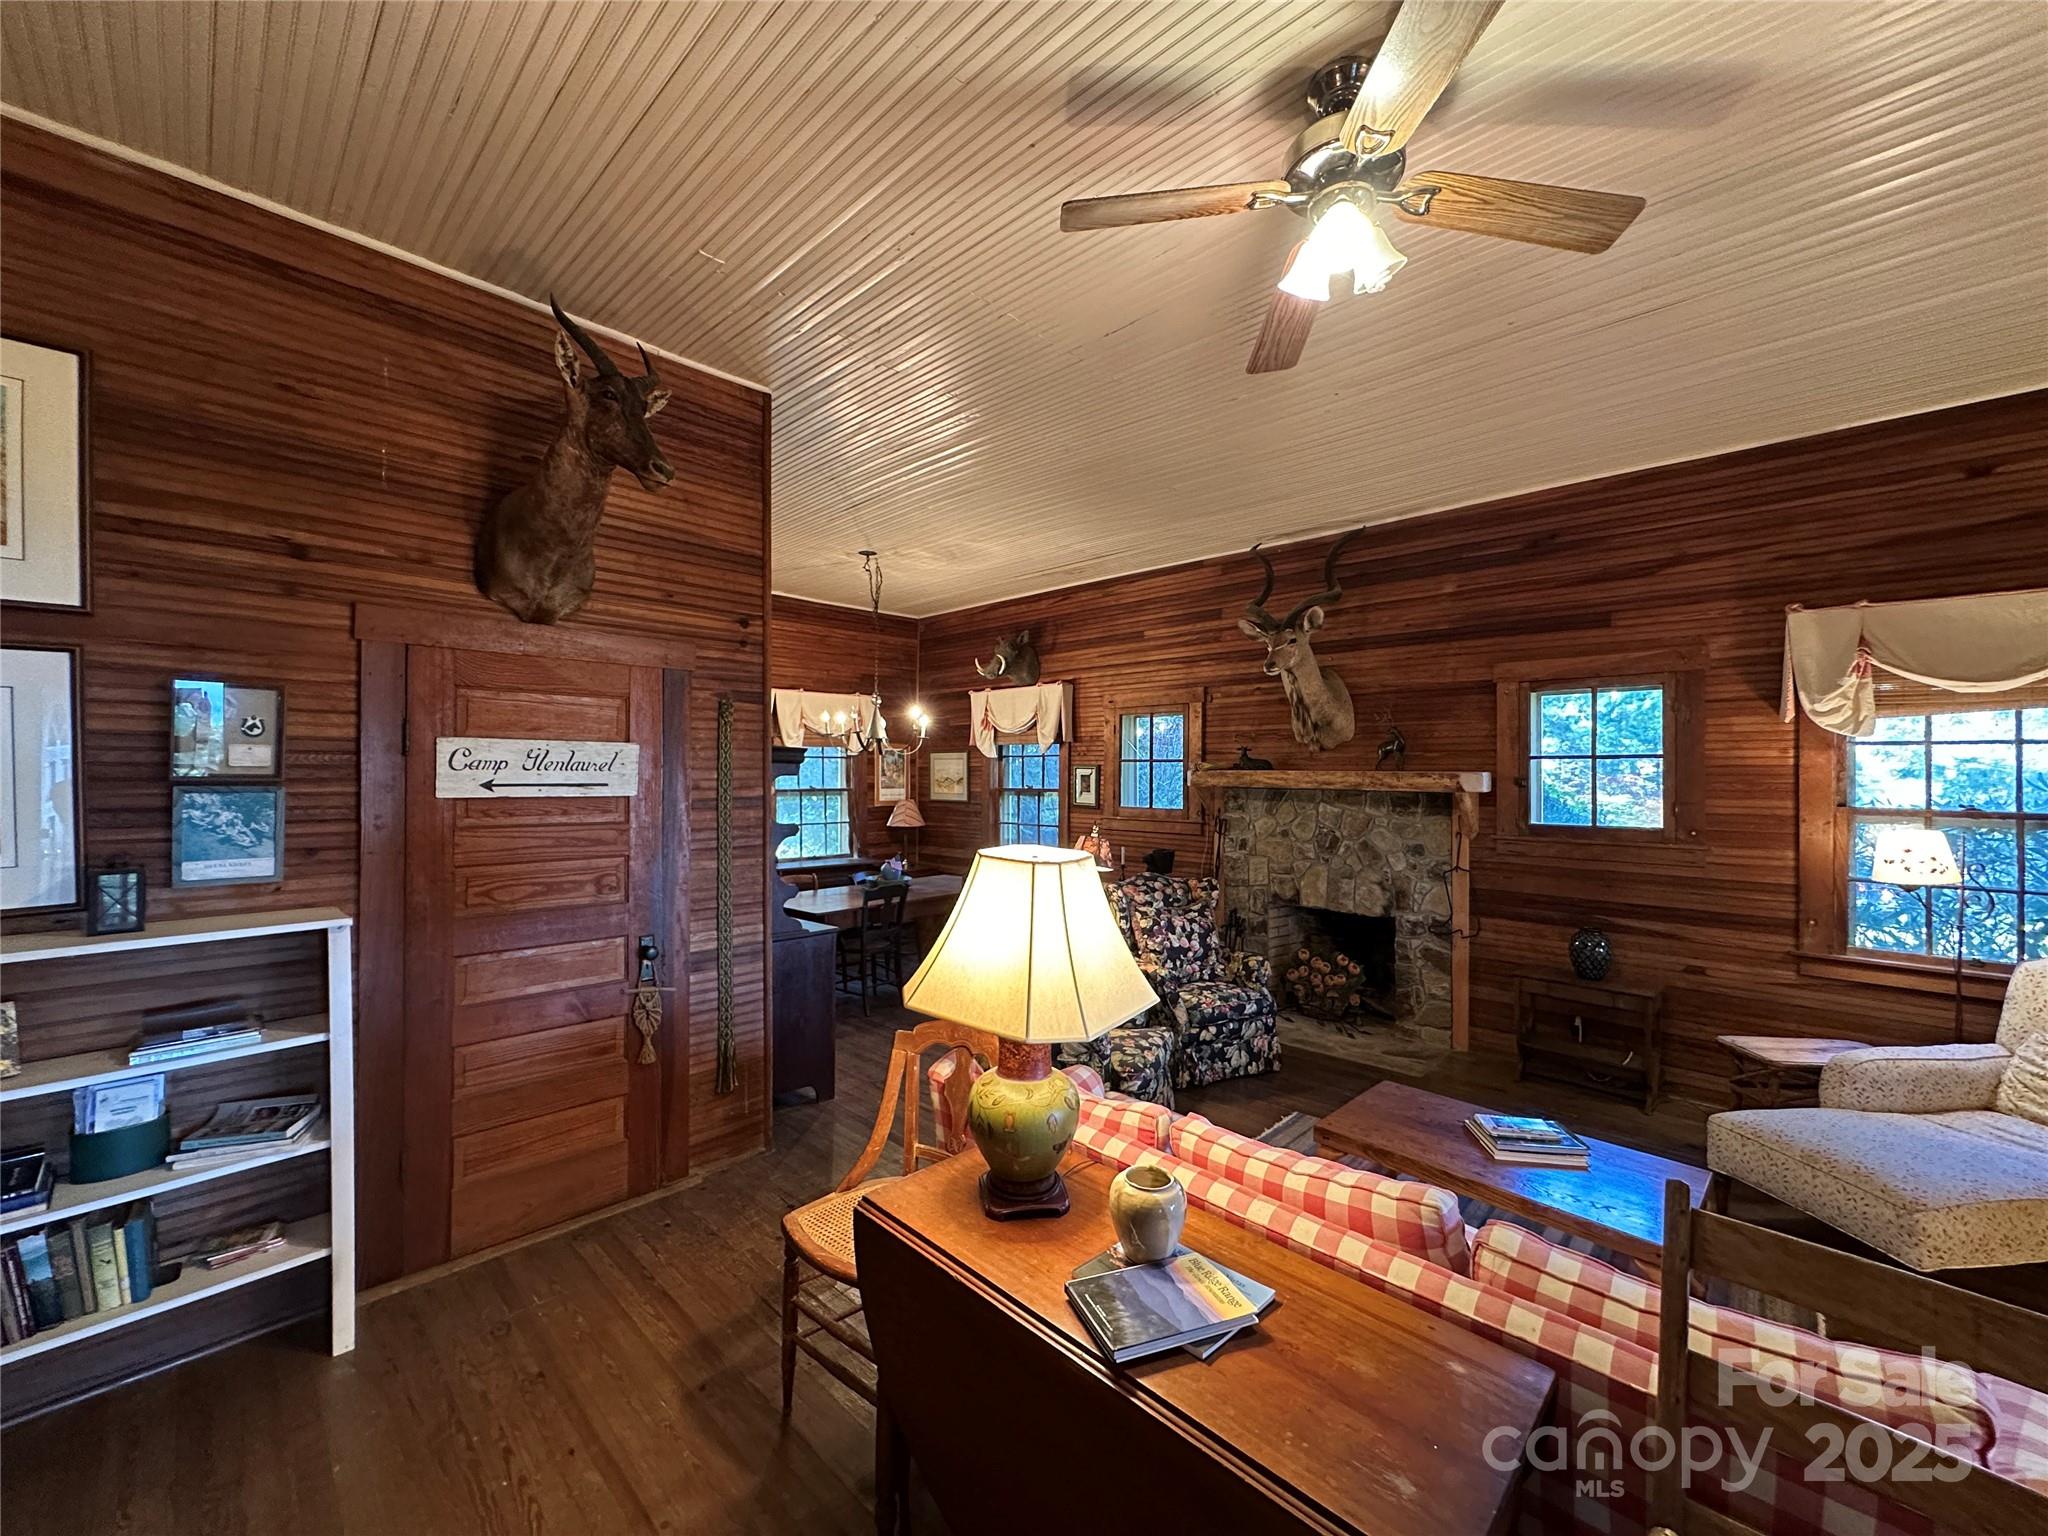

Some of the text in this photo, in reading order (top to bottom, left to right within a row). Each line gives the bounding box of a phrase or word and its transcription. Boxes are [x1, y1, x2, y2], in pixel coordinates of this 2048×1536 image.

[448, 746, 620, 775] Camp Glenlaurel
[1188, 1257, 1205, 1272] Blue
[1201, 1269, 1222, 1288] Ridge
[1218, 1284, 1243, 1309] Range
